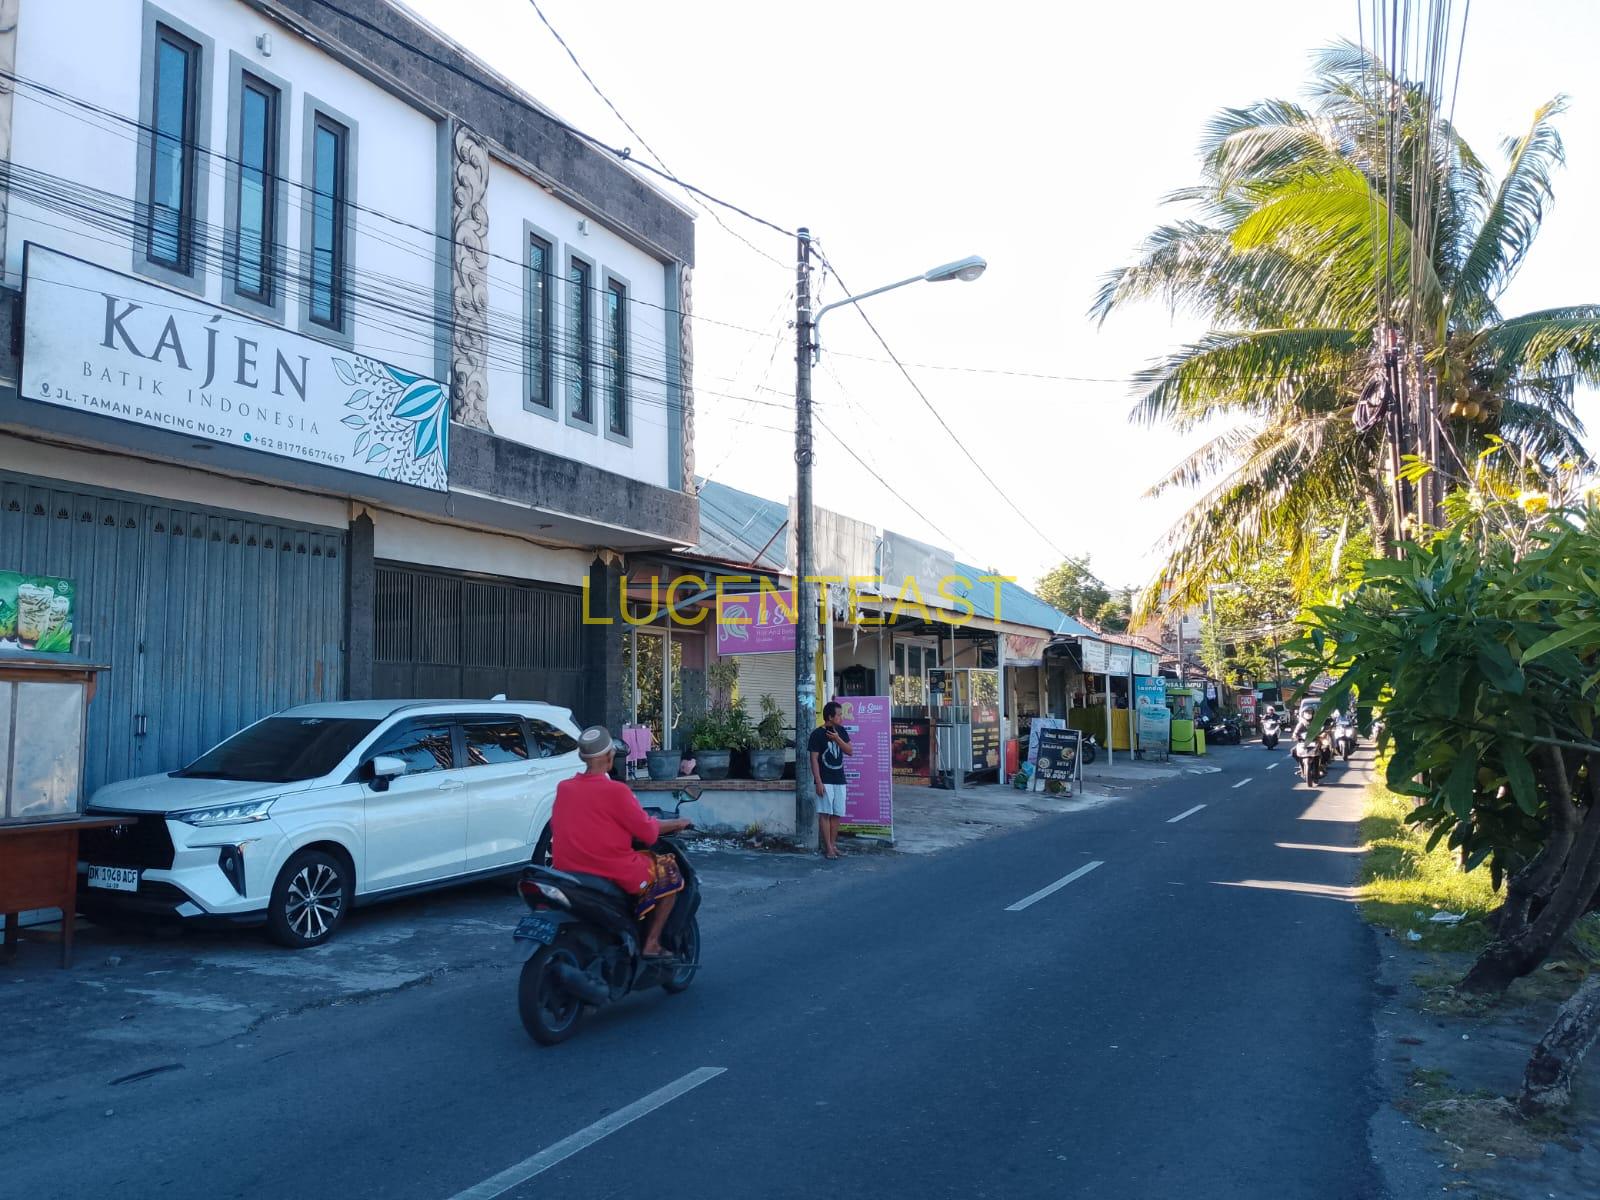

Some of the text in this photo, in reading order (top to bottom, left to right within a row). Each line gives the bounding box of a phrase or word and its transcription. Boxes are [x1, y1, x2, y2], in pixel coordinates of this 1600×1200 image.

[56, 388, 233, 438] JL. TAMAN PANCING NO.27
[83, 361, 319, 435] BATIK INDONESIA
[254, 436, 345, 464] +62 81776677467
[89, 867, 99, 881] DK
